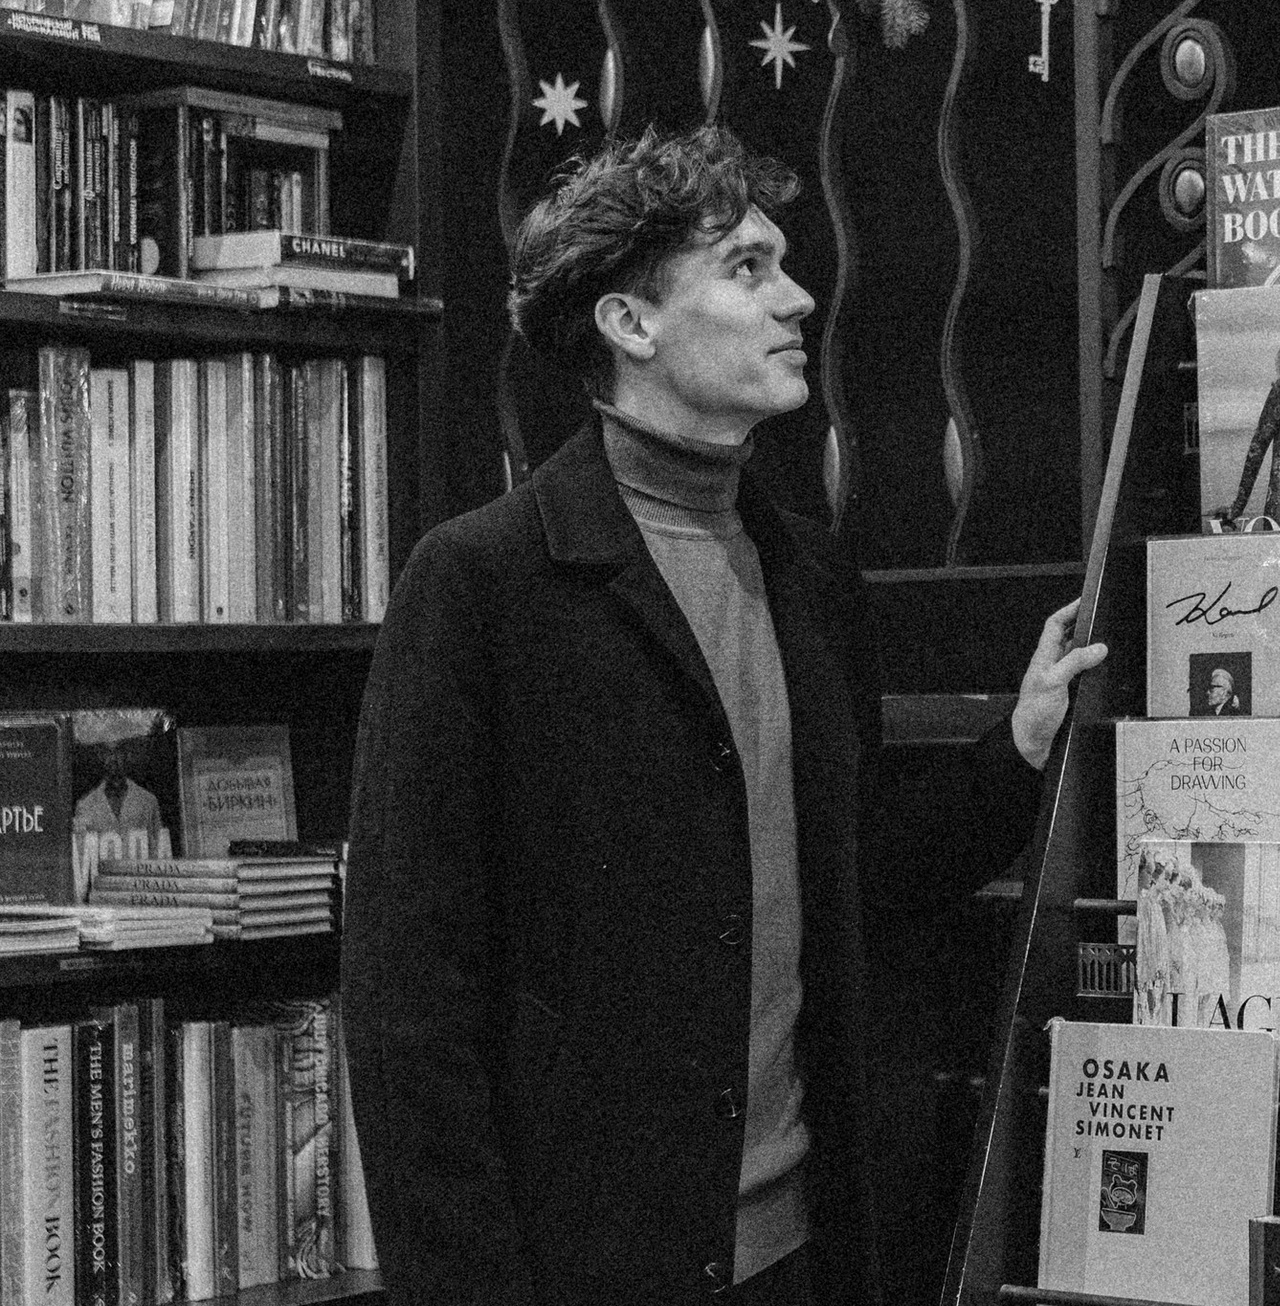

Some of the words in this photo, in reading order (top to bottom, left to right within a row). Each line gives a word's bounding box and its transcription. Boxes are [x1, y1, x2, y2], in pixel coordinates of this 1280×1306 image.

[292, 240, 347, 259] CHANEL
[1169, 738, 1180, 754] A
[1184, 736, 1248, 754] PASSION
[1193, 756, 1223, 772] FOR
[1170, 774, 1247, 791] DRAWING
[135, 862, 180, 876] PRADA
[132, 878, 180, 892] PRADA
[130, 894, 180, 907] PRADA
[42, 1038, 58, 1095] THE
[90, 1041, 102, 1081] THE
[1082, 1058, 1170, 1084] OSAKA
[1076, 1082, 1125, 1100] JEAN
[90, 1084, 103, 1139] MEN'S
[122, 1043, 137, 1175] marimekko
[1089, 1101, 1174, 1123] VINCENT
[1075, 1120, 1164, 1141] SIMONET
[44, 1099, 61, 1210] FASHION
[91, 1142, 104, 1219] FASHION
[45, 1217, 62, 1294] BOOK
[92, 1222, 106, 1274] BOOK
